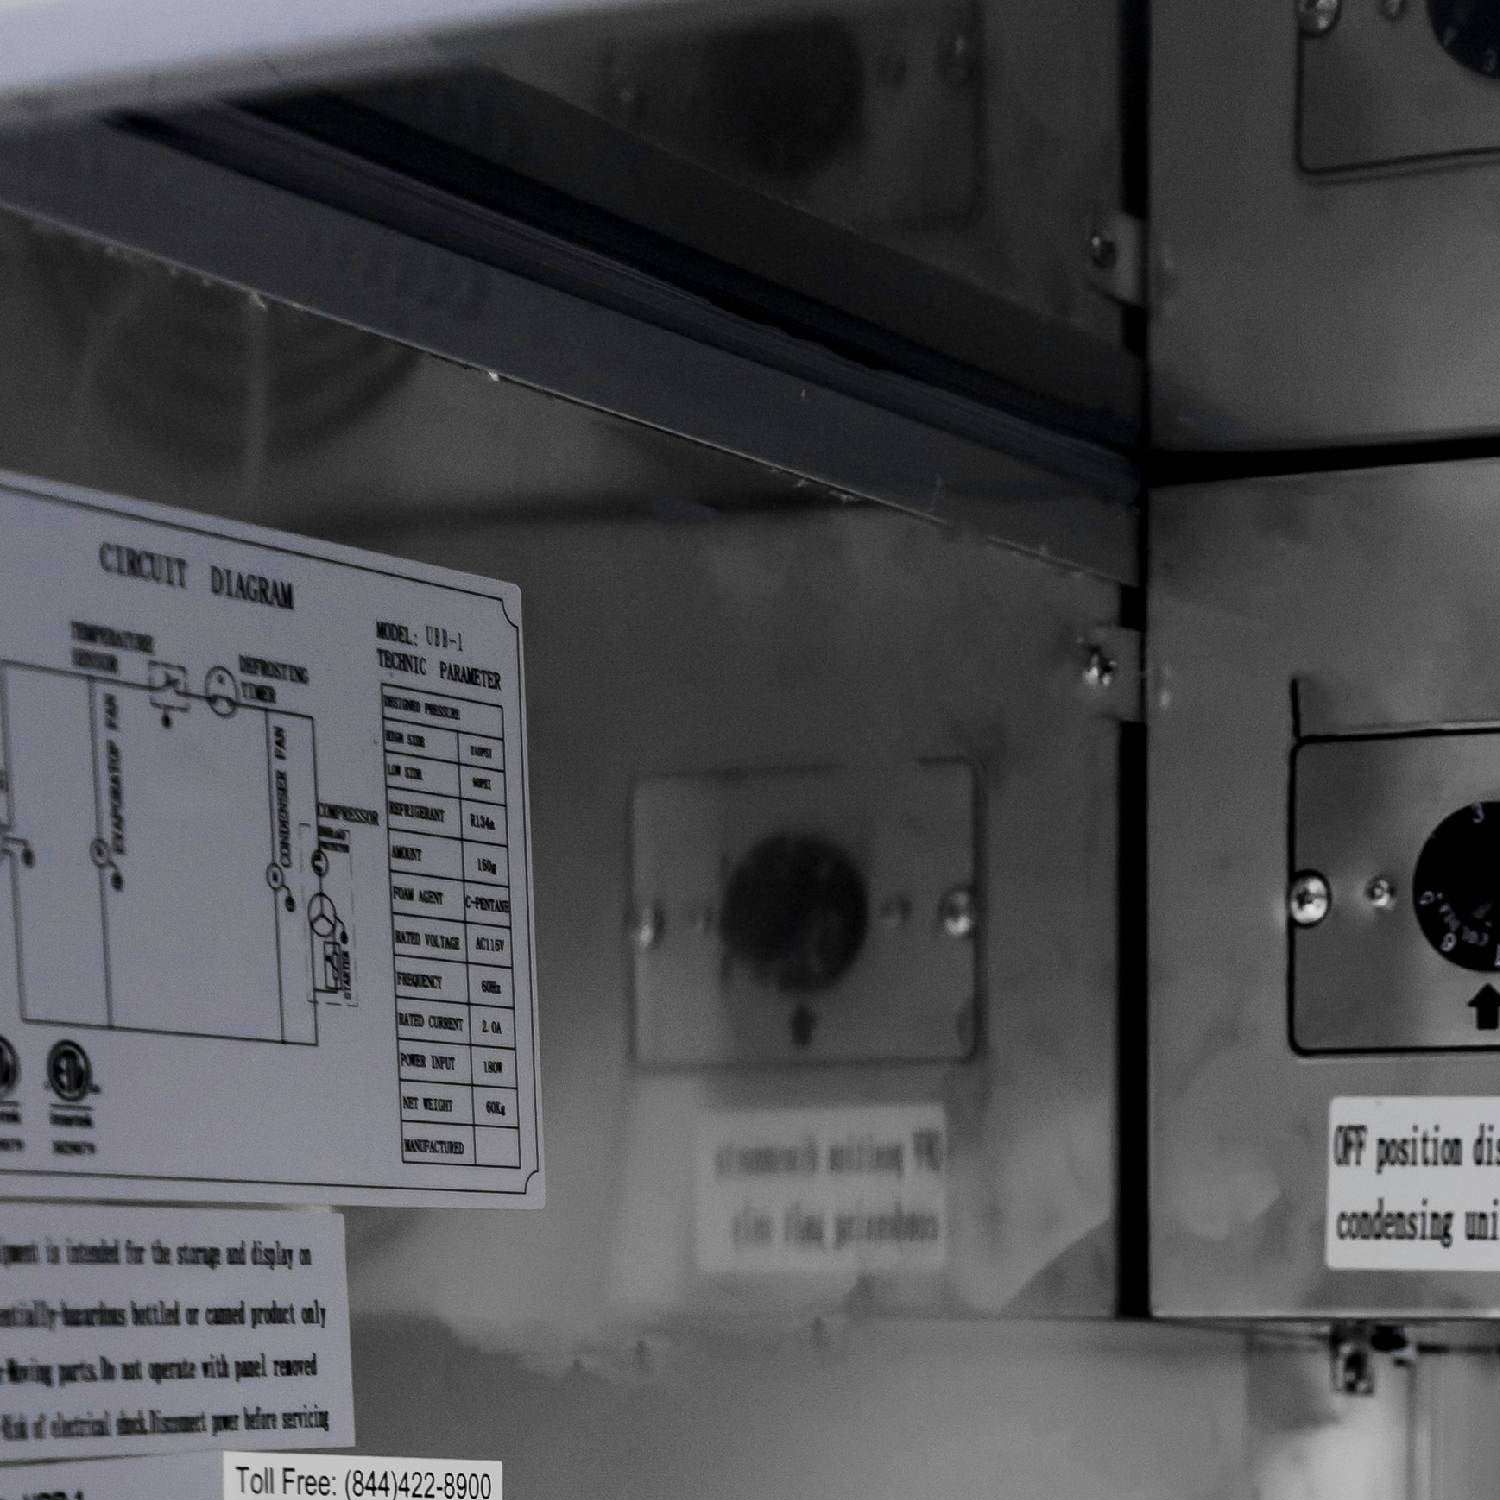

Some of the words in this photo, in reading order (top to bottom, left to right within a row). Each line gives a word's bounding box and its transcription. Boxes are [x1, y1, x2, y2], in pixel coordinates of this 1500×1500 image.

[99, 542, 187, 589] CIRCUIT
[210, 565, 294, 610] DIAGRAM
[376, 620, 418, 647] MODEL:
[376, 648, 427, 676] TECHNIC
[439, 661, 502, 691] PARAMETER
[389, 800, 445, 824] REFRIGERANT
[392, 845, 422, 862] AMOUNT
[419, 889, 444, 905] AGENT
[395, 929, 421, 944] RATED
[425, 932, 460, 950] VOLTAGE
[475, 935, 504, 952] AC115V
[397, 971, 442, 990] FREQUENCY
[399, 1012, 424, 1028] RATED
[428, 1015, 463, 1032] CURRENT
[400, 1052, 427, 1068] POWER
[431, 1055, 455, 1071] INPUT
[402, 1095, 418, 1110] NET
[423, 1096, 452, 1113] WEIGHT
[403, 1138, 465, 1155] MANUFACTURED
[1334, 1124, 1368, 1167] OFF
[1376, 1124, 1463, 1176] position
[1336, 1197, 1455, 1249] condensing
[125, 1238, 146, 1265] for
[151, 1239, 171, 1265] the
[176, 1243, 221, 1270] storage
[226, 1239, 246, 1265] and
[251, 1239, 293, 1270] display
[185, 1307, 199, 1326] or
[205, 1300, 245, 1326] canned
[251, 1299, 295, 1329] product
[301, 1299, 326, 1328] only
[121, 1359, 142, 1381] not
[148, 1360, 196, 1385] operate
[202, 1353, 229, 1379] with
[234, 1353, 268, 1382] panel
[272, 1352, 317, 1377] removed
[243, 1405, 277, 1431] before
[281, 1403, 329, 1432] servicing
[235, 1466, 275, 1495] Toll
[282, 1466, 337, 1497] Free:
